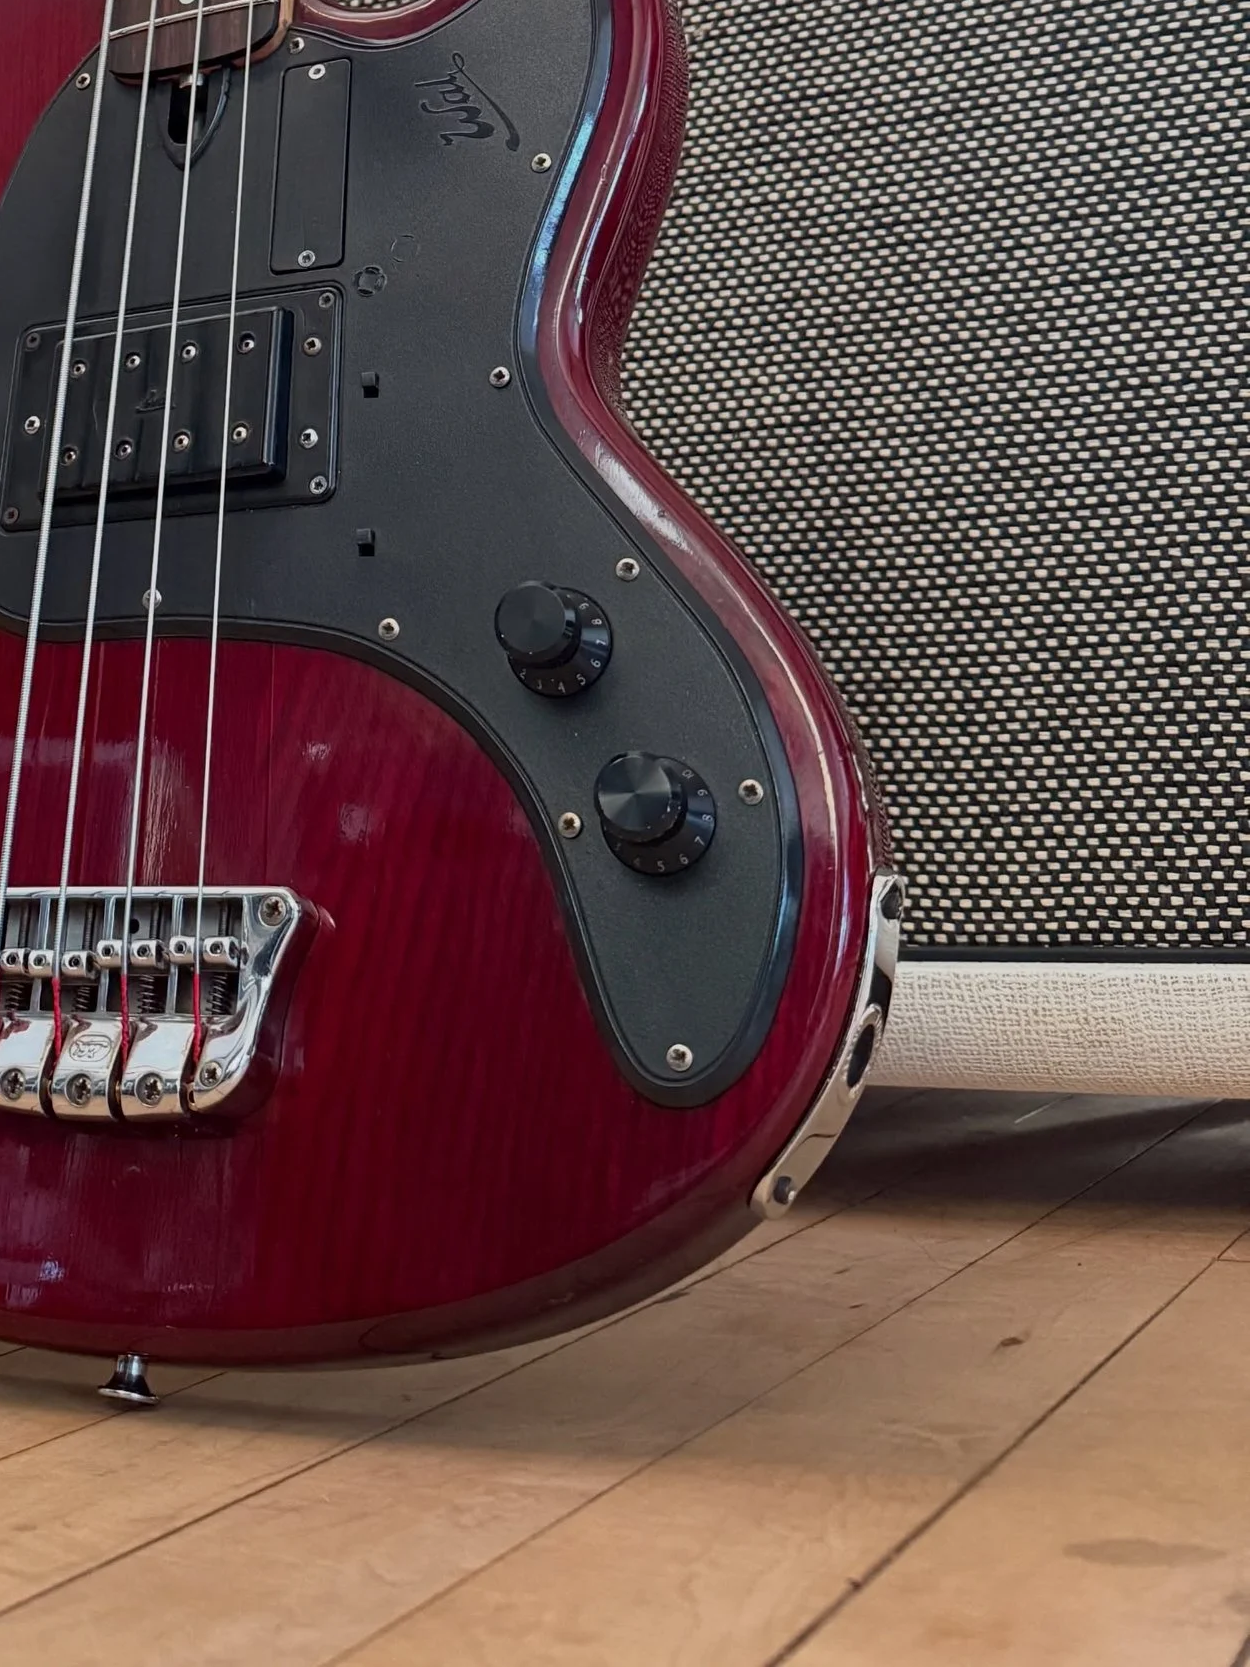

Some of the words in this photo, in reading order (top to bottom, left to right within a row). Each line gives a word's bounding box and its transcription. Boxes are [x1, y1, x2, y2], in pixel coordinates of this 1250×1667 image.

[414, 50, 521, 152] Wal
[591, 618, 603, 626] 8
[590, 658, 601, 668] 6
[576, 673, 586, 686] 5
[697, 789, 708, 797] 9
[701, 814, 713, 822] 8
[694, 835, 705, 847] 7
[678, 853, 689, 865] 6
[657, 860, 666, 872] 5
